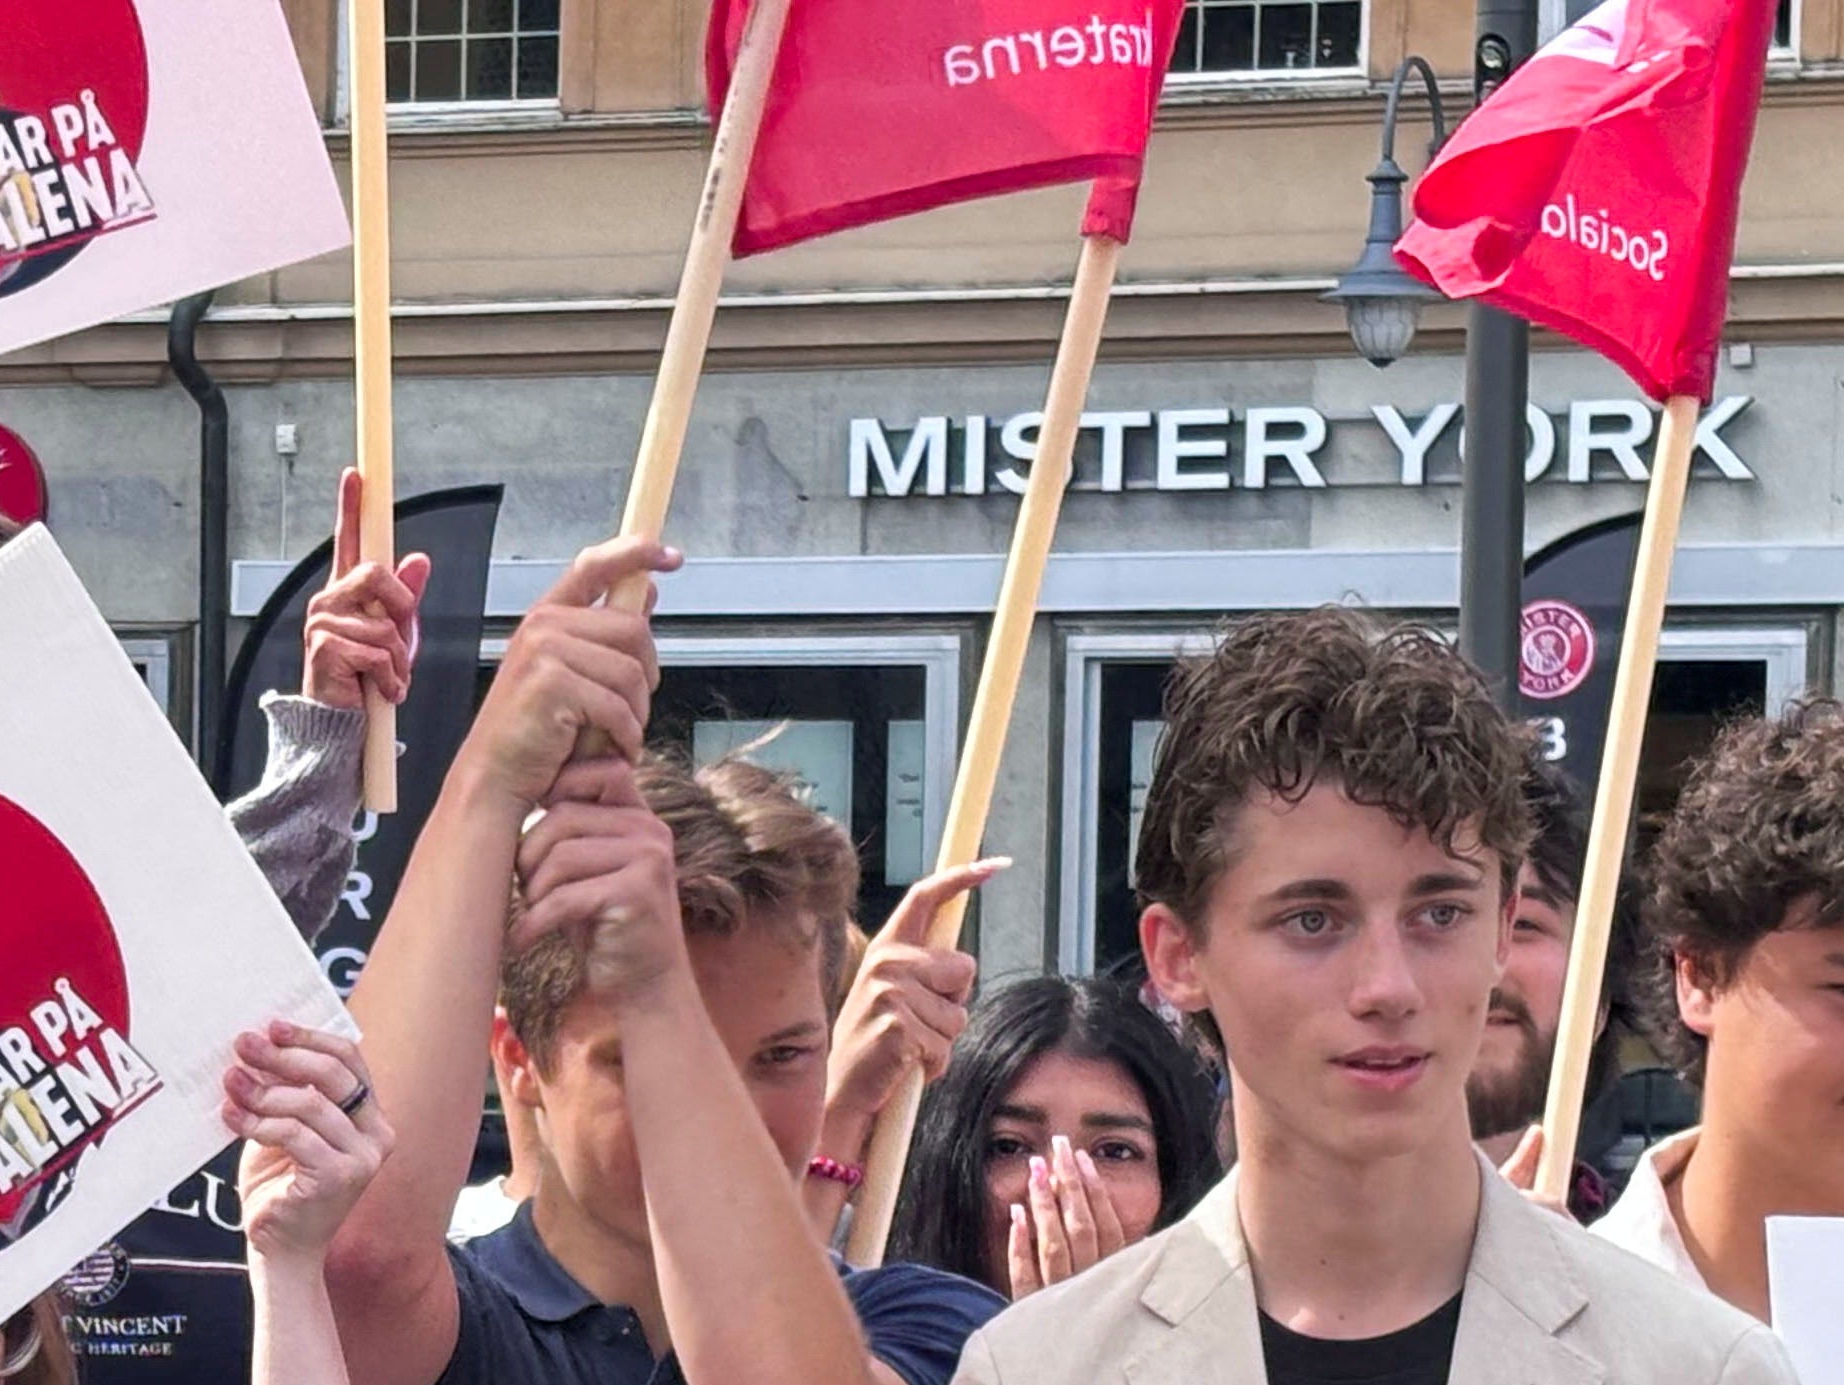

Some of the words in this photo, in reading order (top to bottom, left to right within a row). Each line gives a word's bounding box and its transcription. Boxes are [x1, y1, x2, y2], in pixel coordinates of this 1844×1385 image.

[51, 88, 116, 157] PÅ
[849, 407, 1327, 497] MISTER
[29, 977, 103, 1058] PÅ
[76, 1315, 188, 1336] VINCENT
[88, 1343, 173, 1355] HERITAGE
